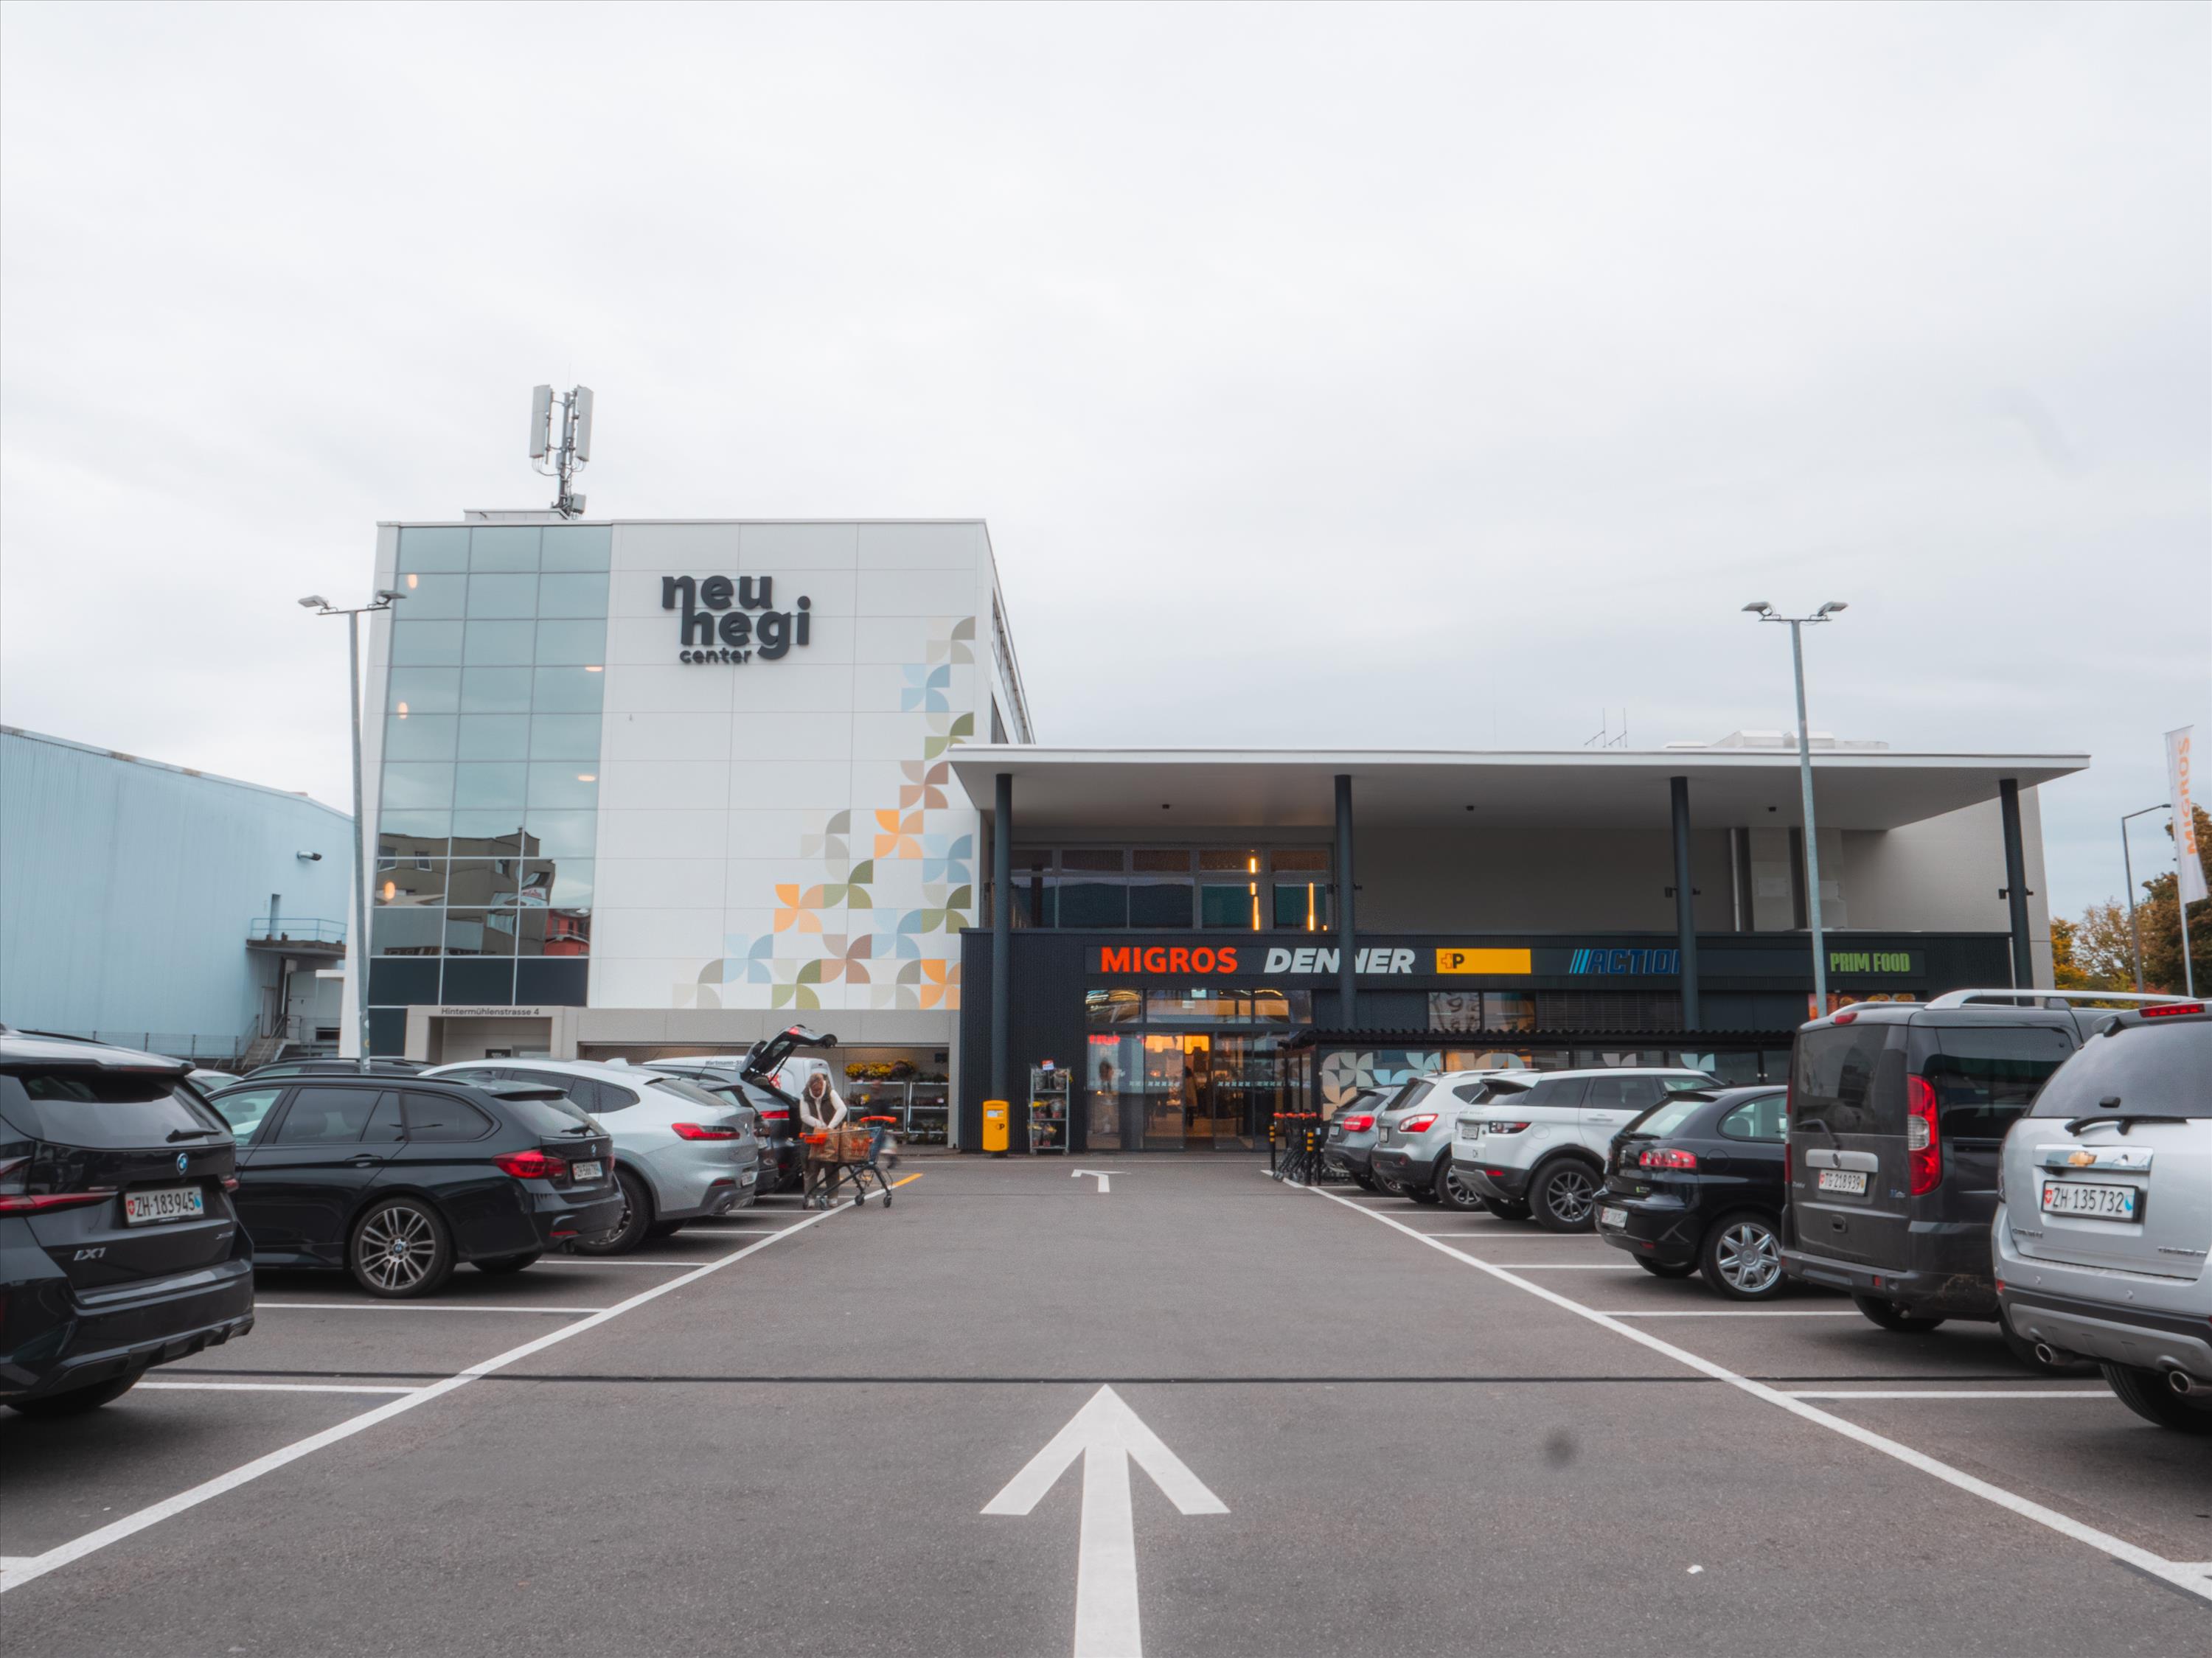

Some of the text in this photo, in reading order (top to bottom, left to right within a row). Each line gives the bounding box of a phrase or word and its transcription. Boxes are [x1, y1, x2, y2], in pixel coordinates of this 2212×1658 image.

[661, 575, 773, 610] neu
[681, 596, 810, 660] hegi
[679, 648, 751, 664] center
[2178, 737, 2197, 854] MIGROS
[1101, 947, 1238, 973] MIGROS
[1830, 952, 1910, 972] PRIM FOOD
[442, 1008, 531, 1016] Hintermühlenstrasse
